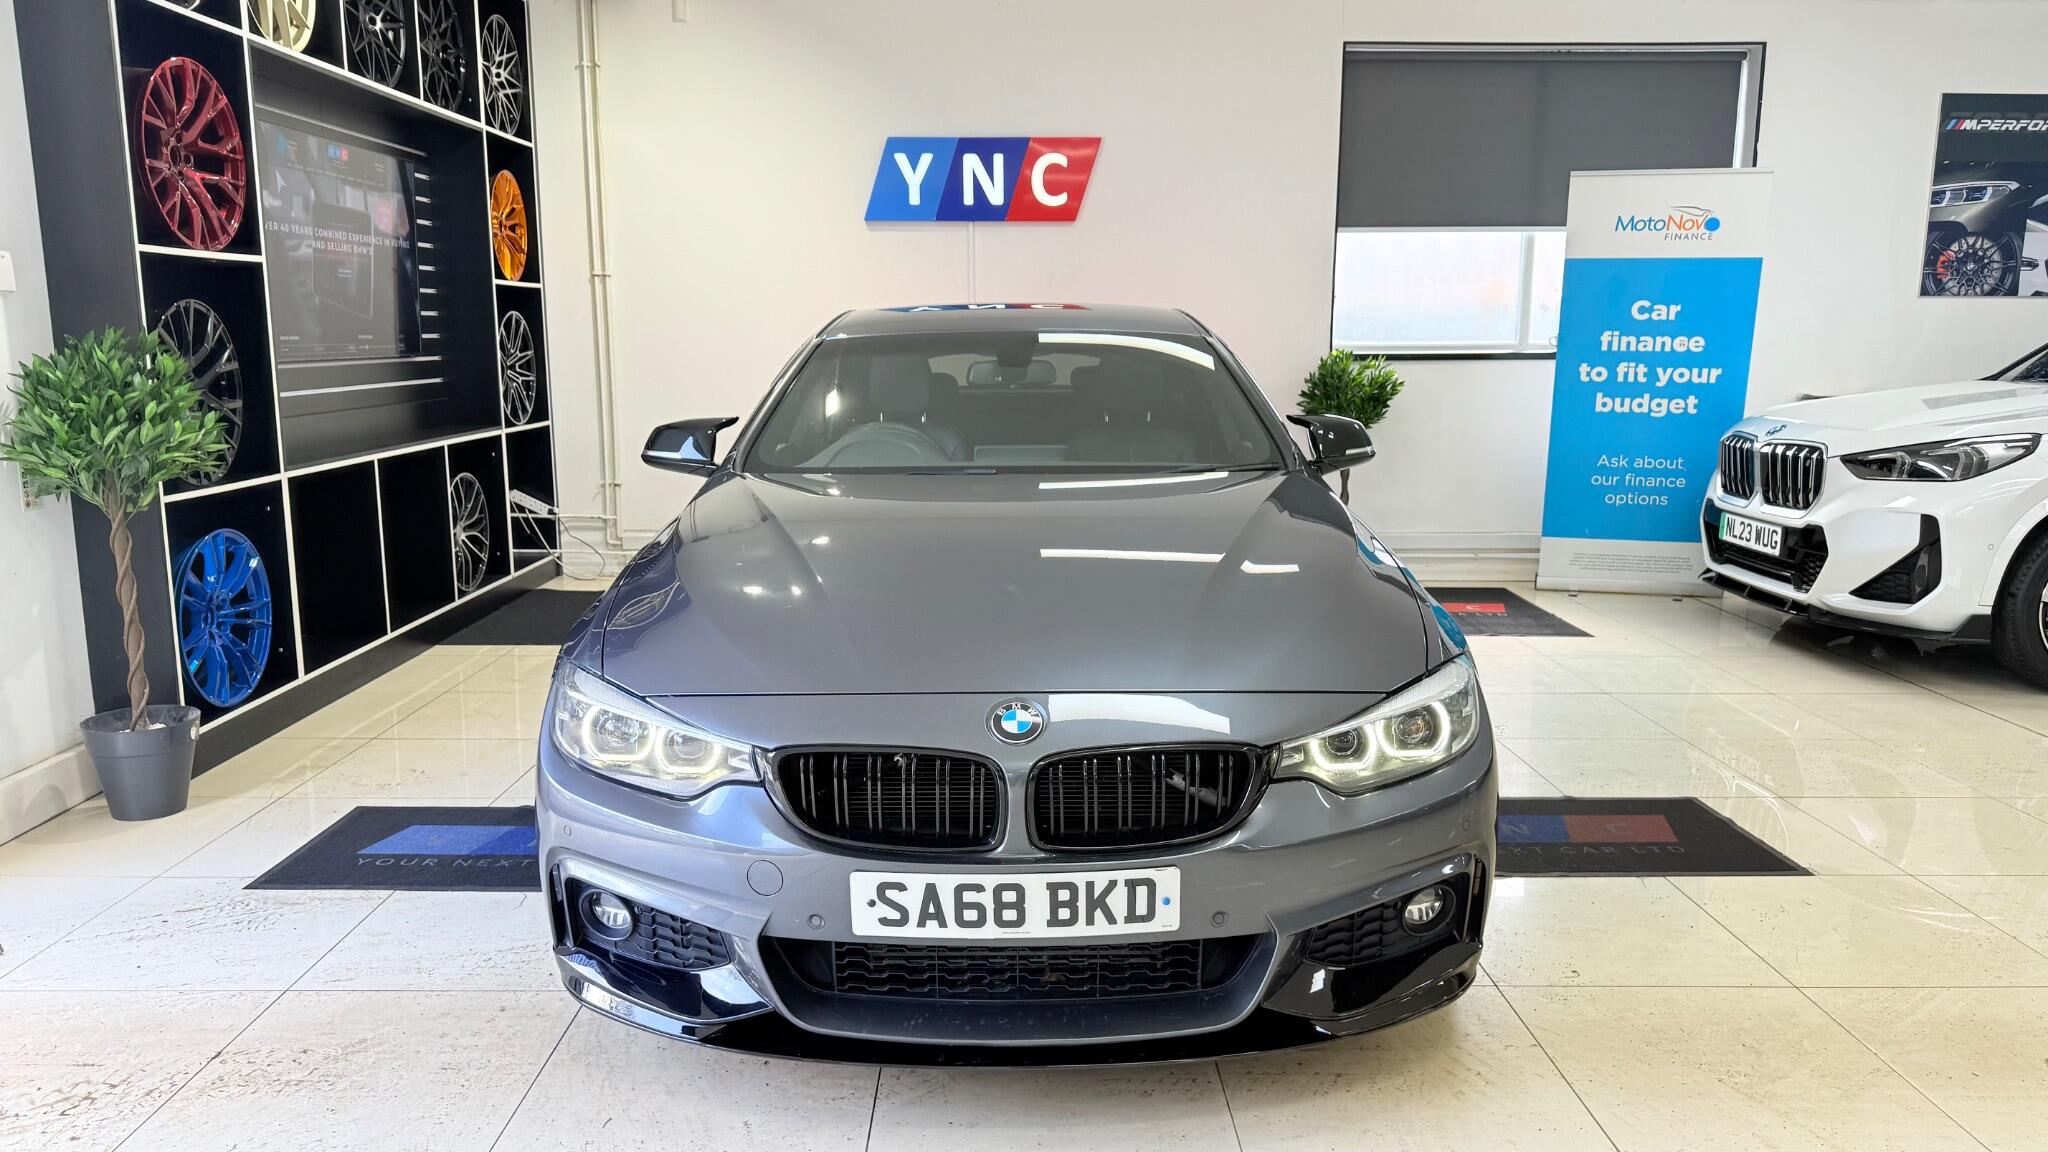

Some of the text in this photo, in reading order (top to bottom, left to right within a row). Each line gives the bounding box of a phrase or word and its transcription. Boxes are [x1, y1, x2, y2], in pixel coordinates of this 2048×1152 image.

[893, 152, 1068, 207] YNC
[291, 224, 313, 235] YEARS
[314, 228, 346, 241] COMBINED
[1664, 233, 1713, 241] FINANCE
[312, 239, 325, 249] AND
[326, 241, 352, 253] SELLING
[1631, 300, 1681, 320] Car
[1600, 330, 1705, 352] finance
[1579, 362, 1722, 387] to fit your
[1595, 392, 1698, 417] budget
[1597, 454, 1629, 468] Ask
[1591, 473, 1686, 487] our finance
[1604, 492, 1668, 506] options
[1725, 515, 1779, 550] NL23 WUG
[996, 703, 1039, 716] BMW
[1559, 846, 1619, 854] CAR
[1630, 845, 1686, 854] LTD
[357, 858, 536, 867] YOUR NEXT
[876, 877, 1157, 929] SA68 BKD
